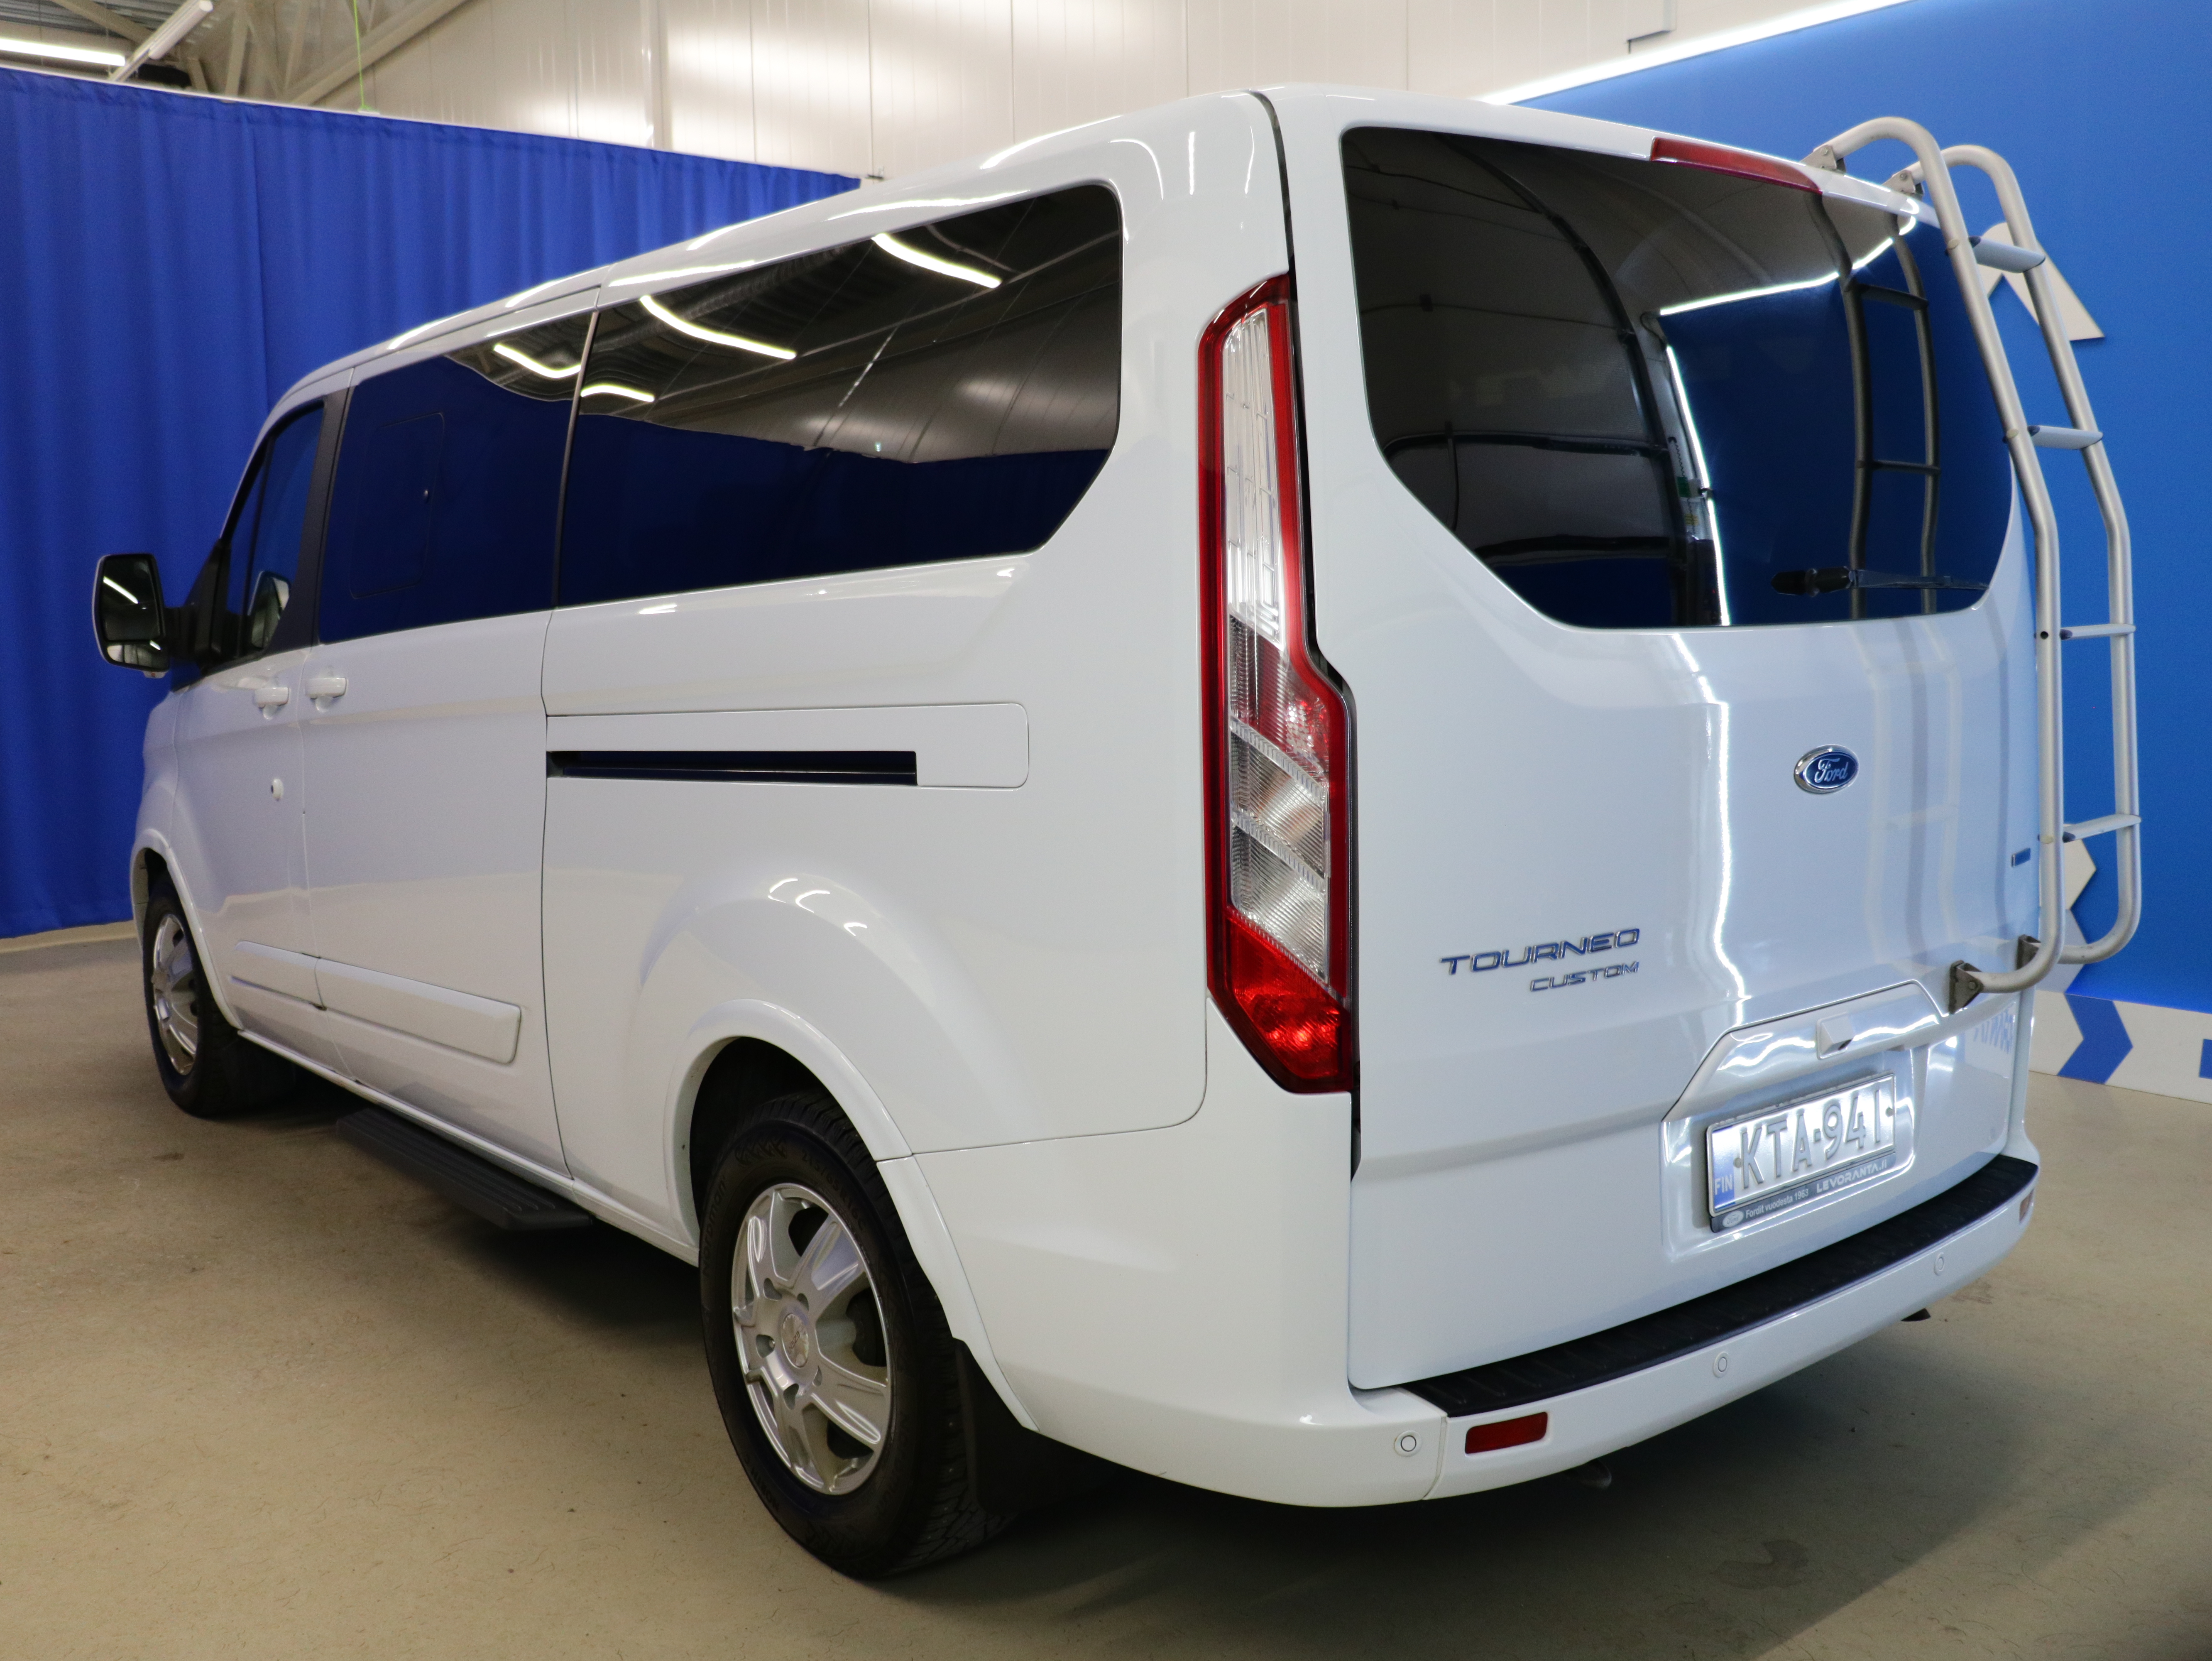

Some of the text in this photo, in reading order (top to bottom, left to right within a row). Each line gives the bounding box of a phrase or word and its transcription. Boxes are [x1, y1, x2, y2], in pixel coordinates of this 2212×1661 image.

[1814, 757, 1849, 784] Ford
[1439, 928, 1640, 975] TOURNEO
[1530, 960, 1640, 992] CUSTOM
[1740, 1089, 1881, 1188] KTA-941
[1714, 1173, 1733, 1195] FIN
[1746, 1188, 1809, 1219] Fordit vuodesta 1963
